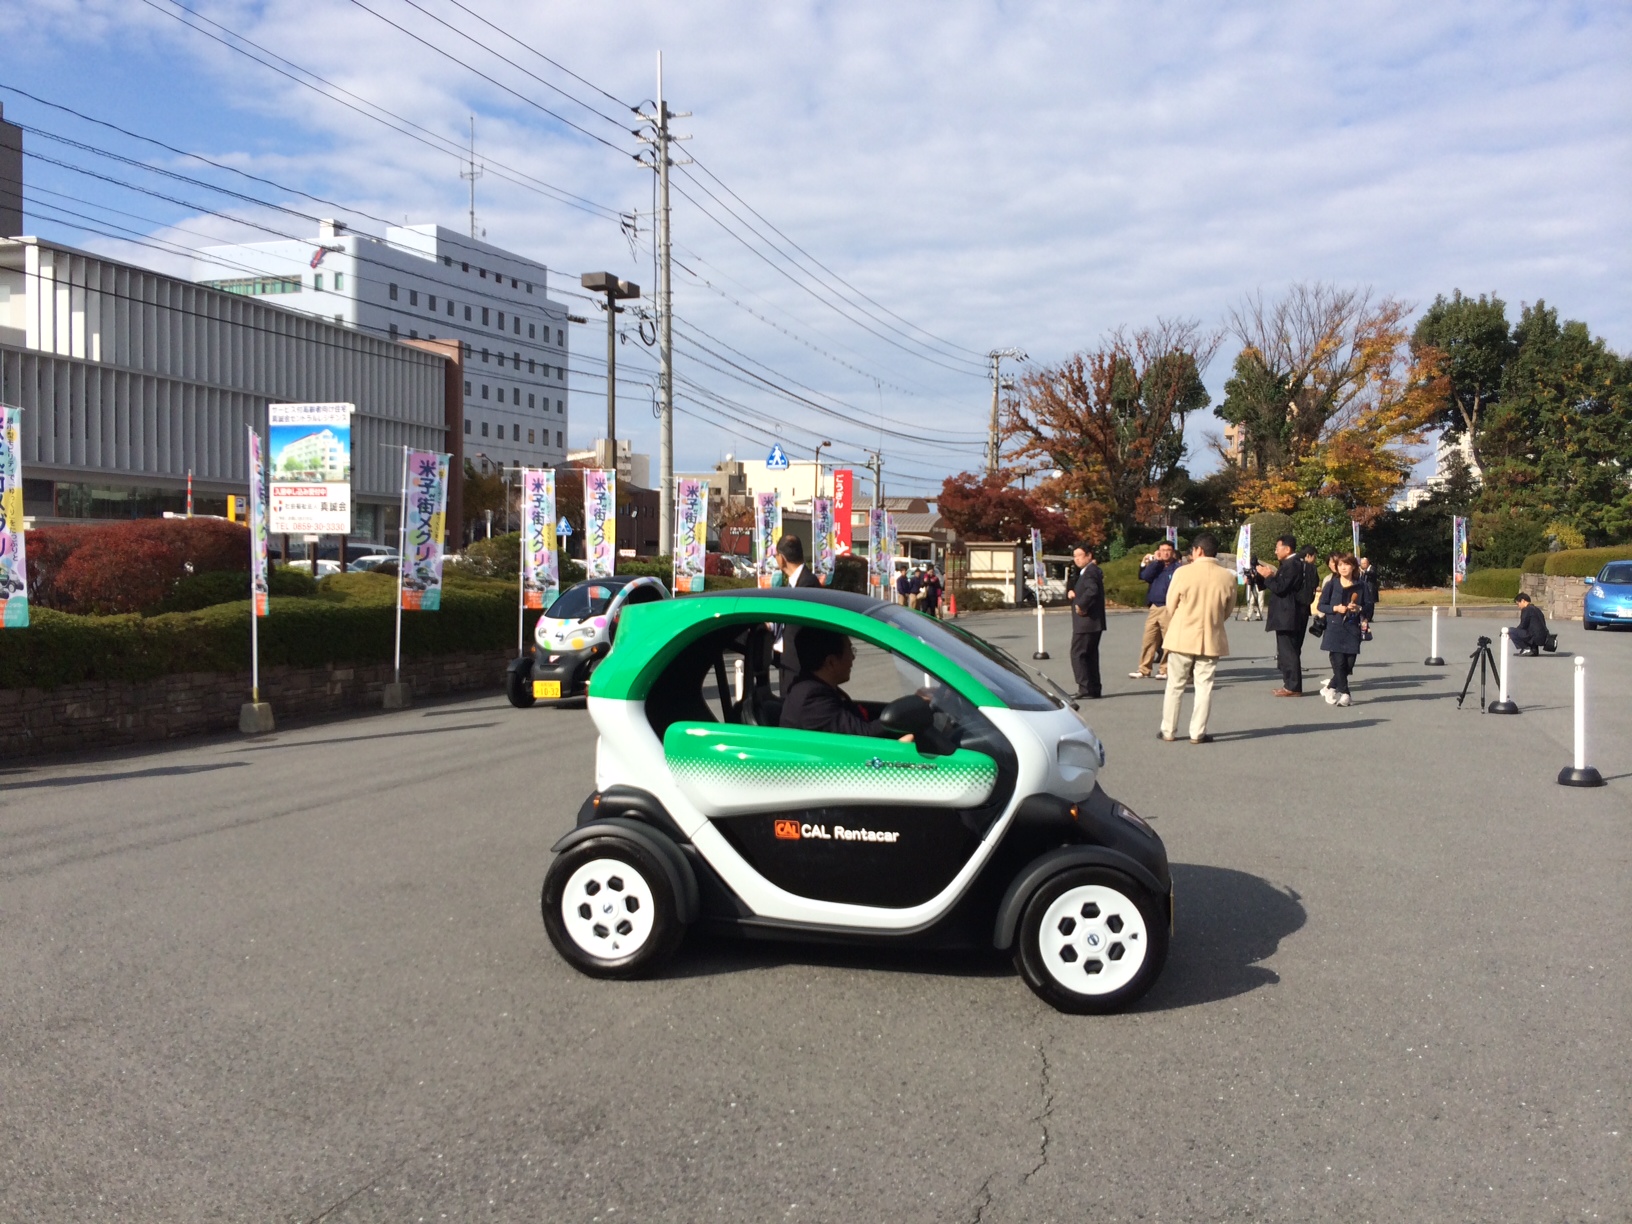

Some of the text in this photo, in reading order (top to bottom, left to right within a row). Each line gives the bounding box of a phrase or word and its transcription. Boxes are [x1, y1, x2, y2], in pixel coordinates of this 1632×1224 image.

[835, 474, 845, 509] ごうぎん
[320, 501, 347, 512] 真誠会
[275, 522, 345, 531] TEL 0859-30-3330
[776, 821, 900, 842] CAL CAL Rentacar
